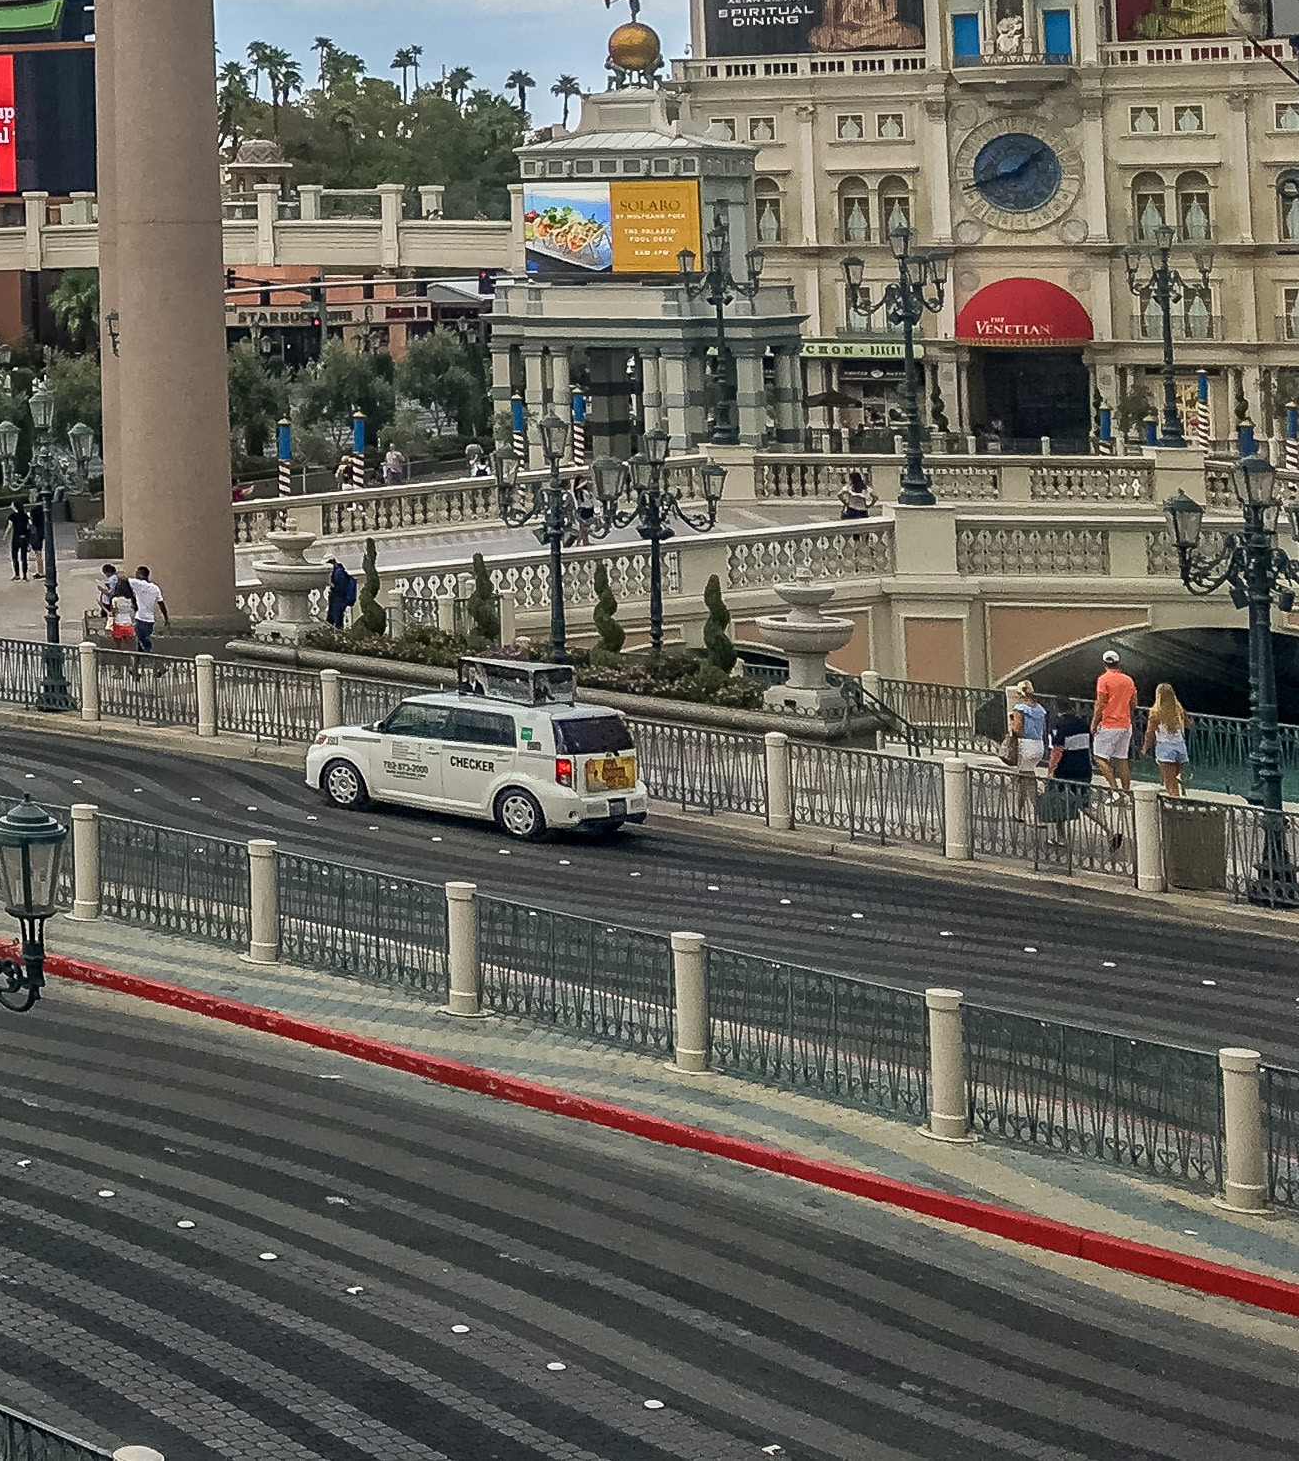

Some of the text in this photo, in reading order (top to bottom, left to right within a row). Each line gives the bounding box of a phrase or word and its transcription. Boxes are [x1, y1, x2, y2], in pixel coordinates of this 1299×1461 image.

[718, 5, 814, 19] SPIRITUAL
[732, 16, 799, 27] DINING
[620, 200, 681, 211] SOLARO
[238, 312, 316, 324] STARBUC
[976, 320, 1052, 335] VENETIAN
[450, 755, 495, 773] CHECKER
